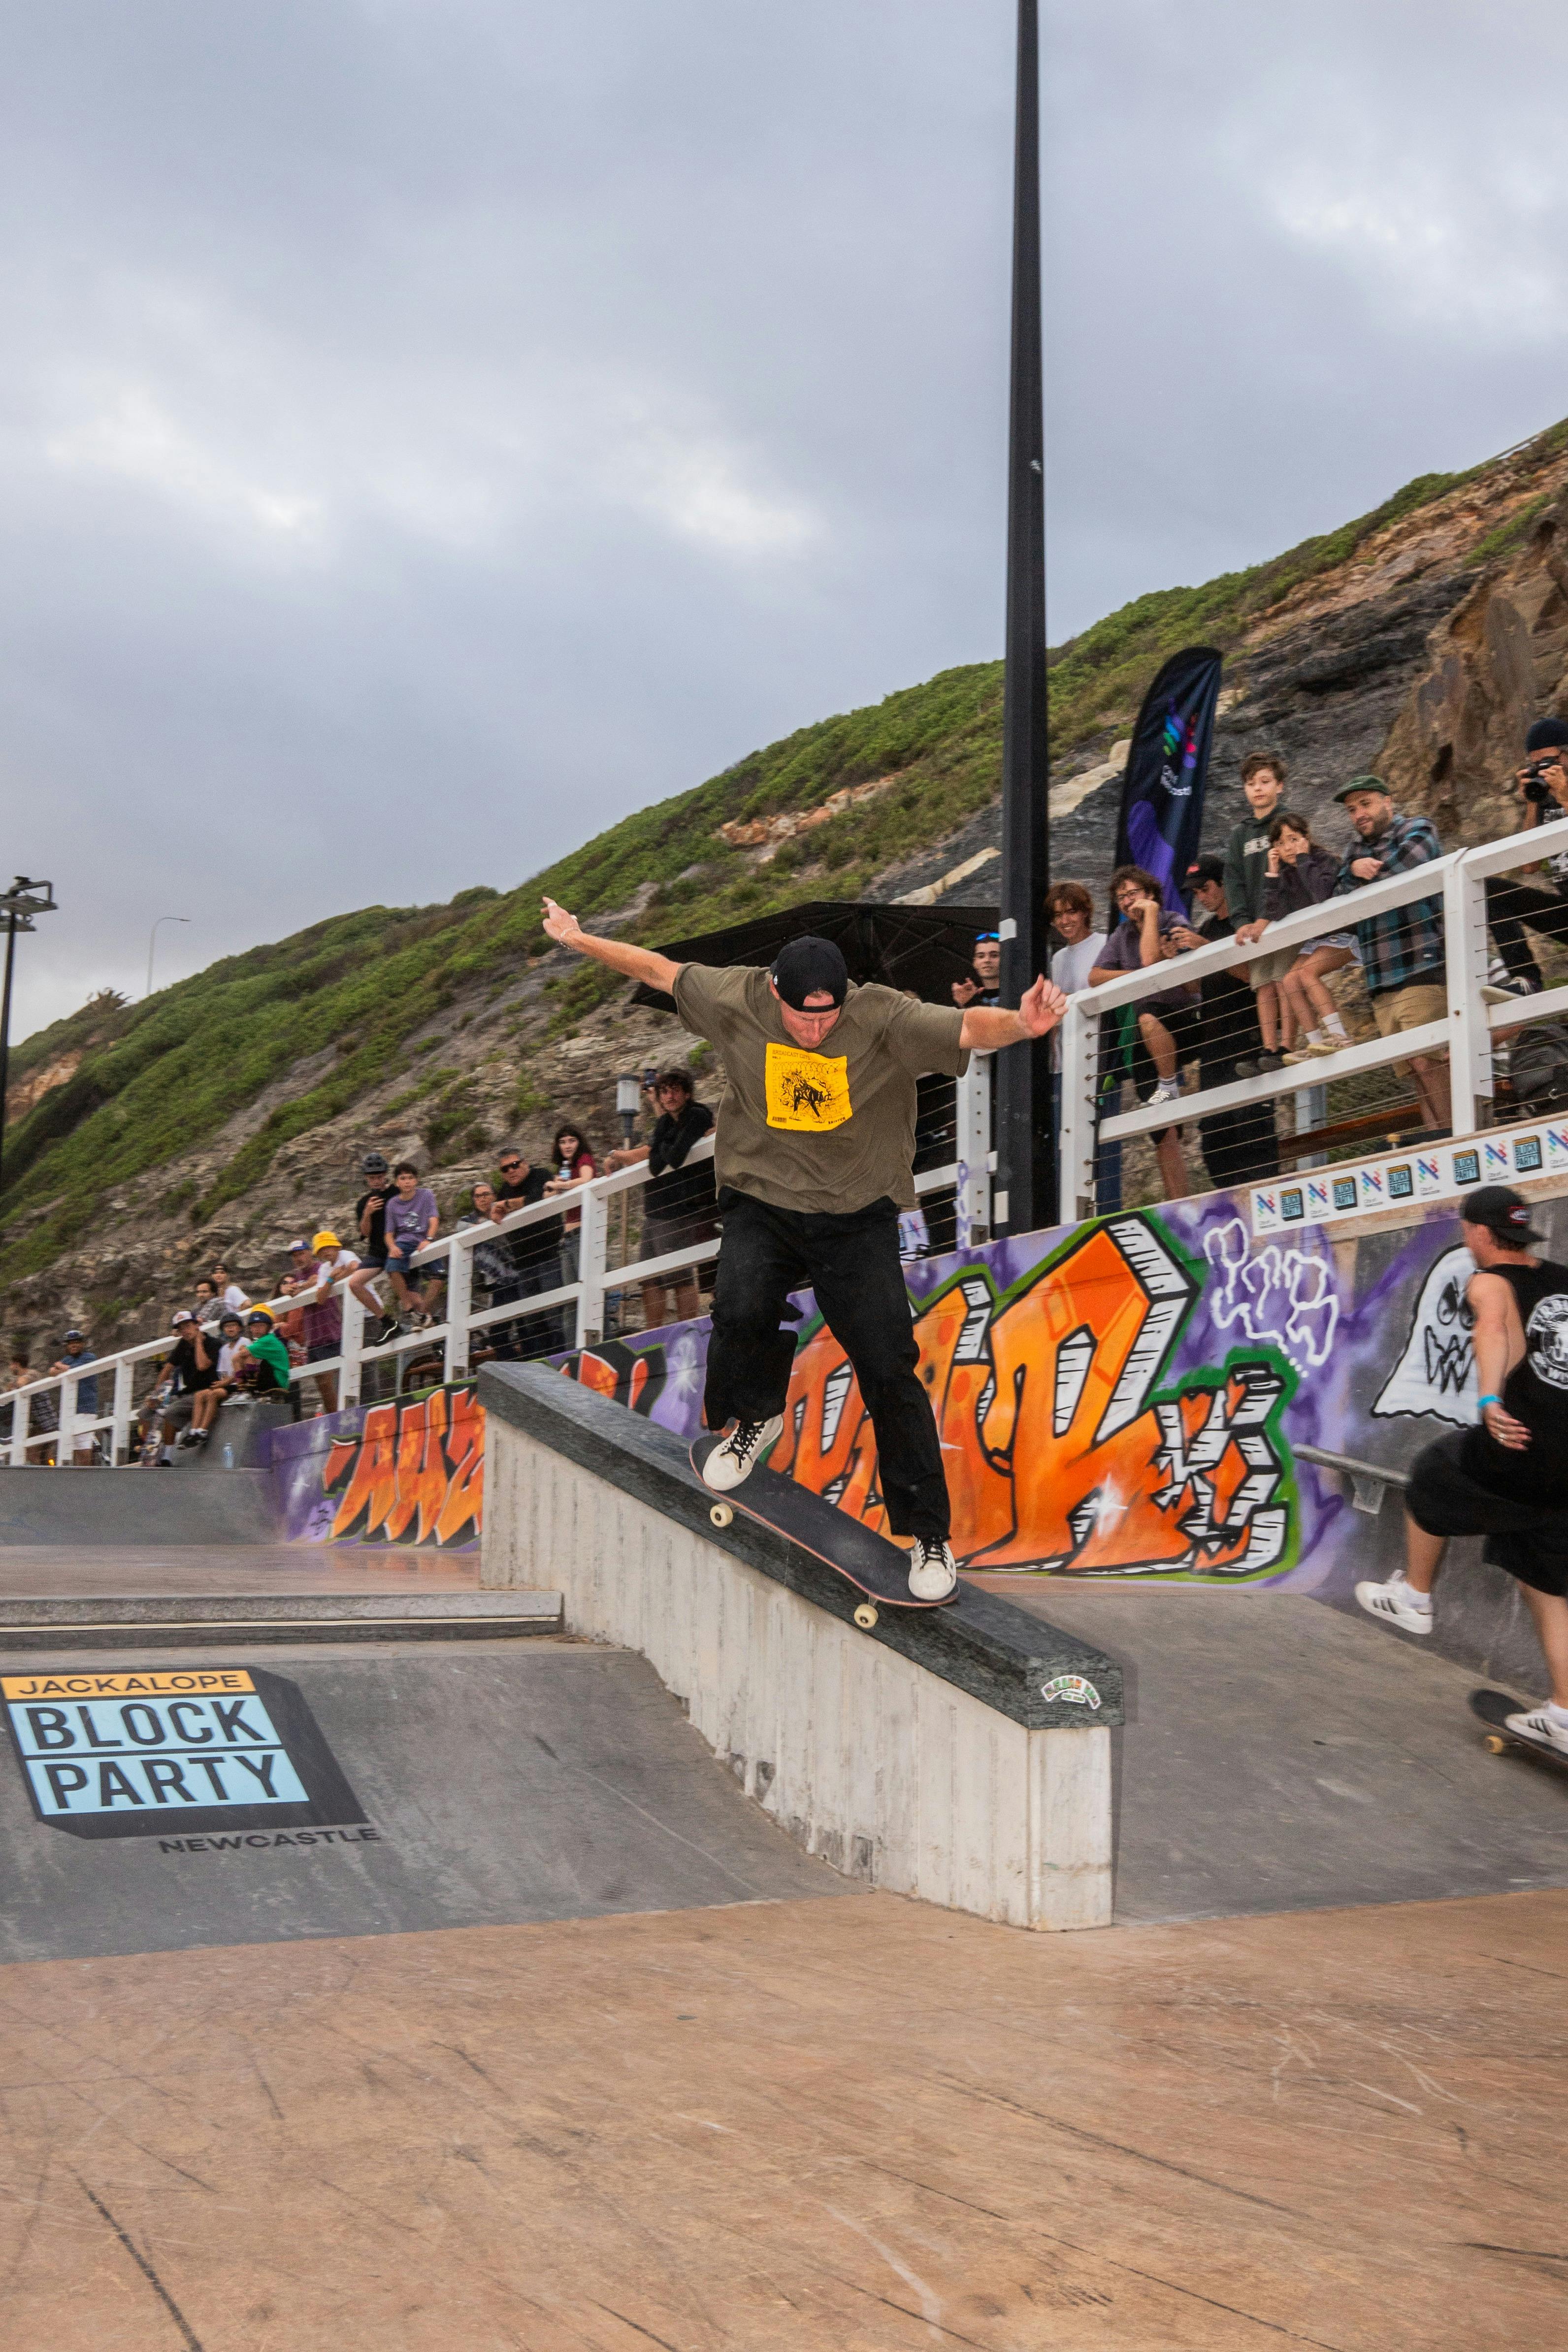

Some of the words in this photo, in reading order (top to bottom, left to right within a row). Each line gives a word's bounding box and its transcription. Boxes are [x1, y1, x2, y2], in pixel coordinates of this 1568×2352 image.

[1515, 1143, 1536, 1156] BLOCK
[1454, 1157, 1475, 1170] BLOCK
[1516, 1155, 1537, 1168] PARTY
[1455, 1168, 1476, 1180] PARTY
[19, 1674, 242, 1695] JACKALOPE
[26, 1700, 267, 1750] BLOCK
[44, 1754, 281, 1809] PARTY
[159, 1828, 382, 1854] NEWCASTLE
